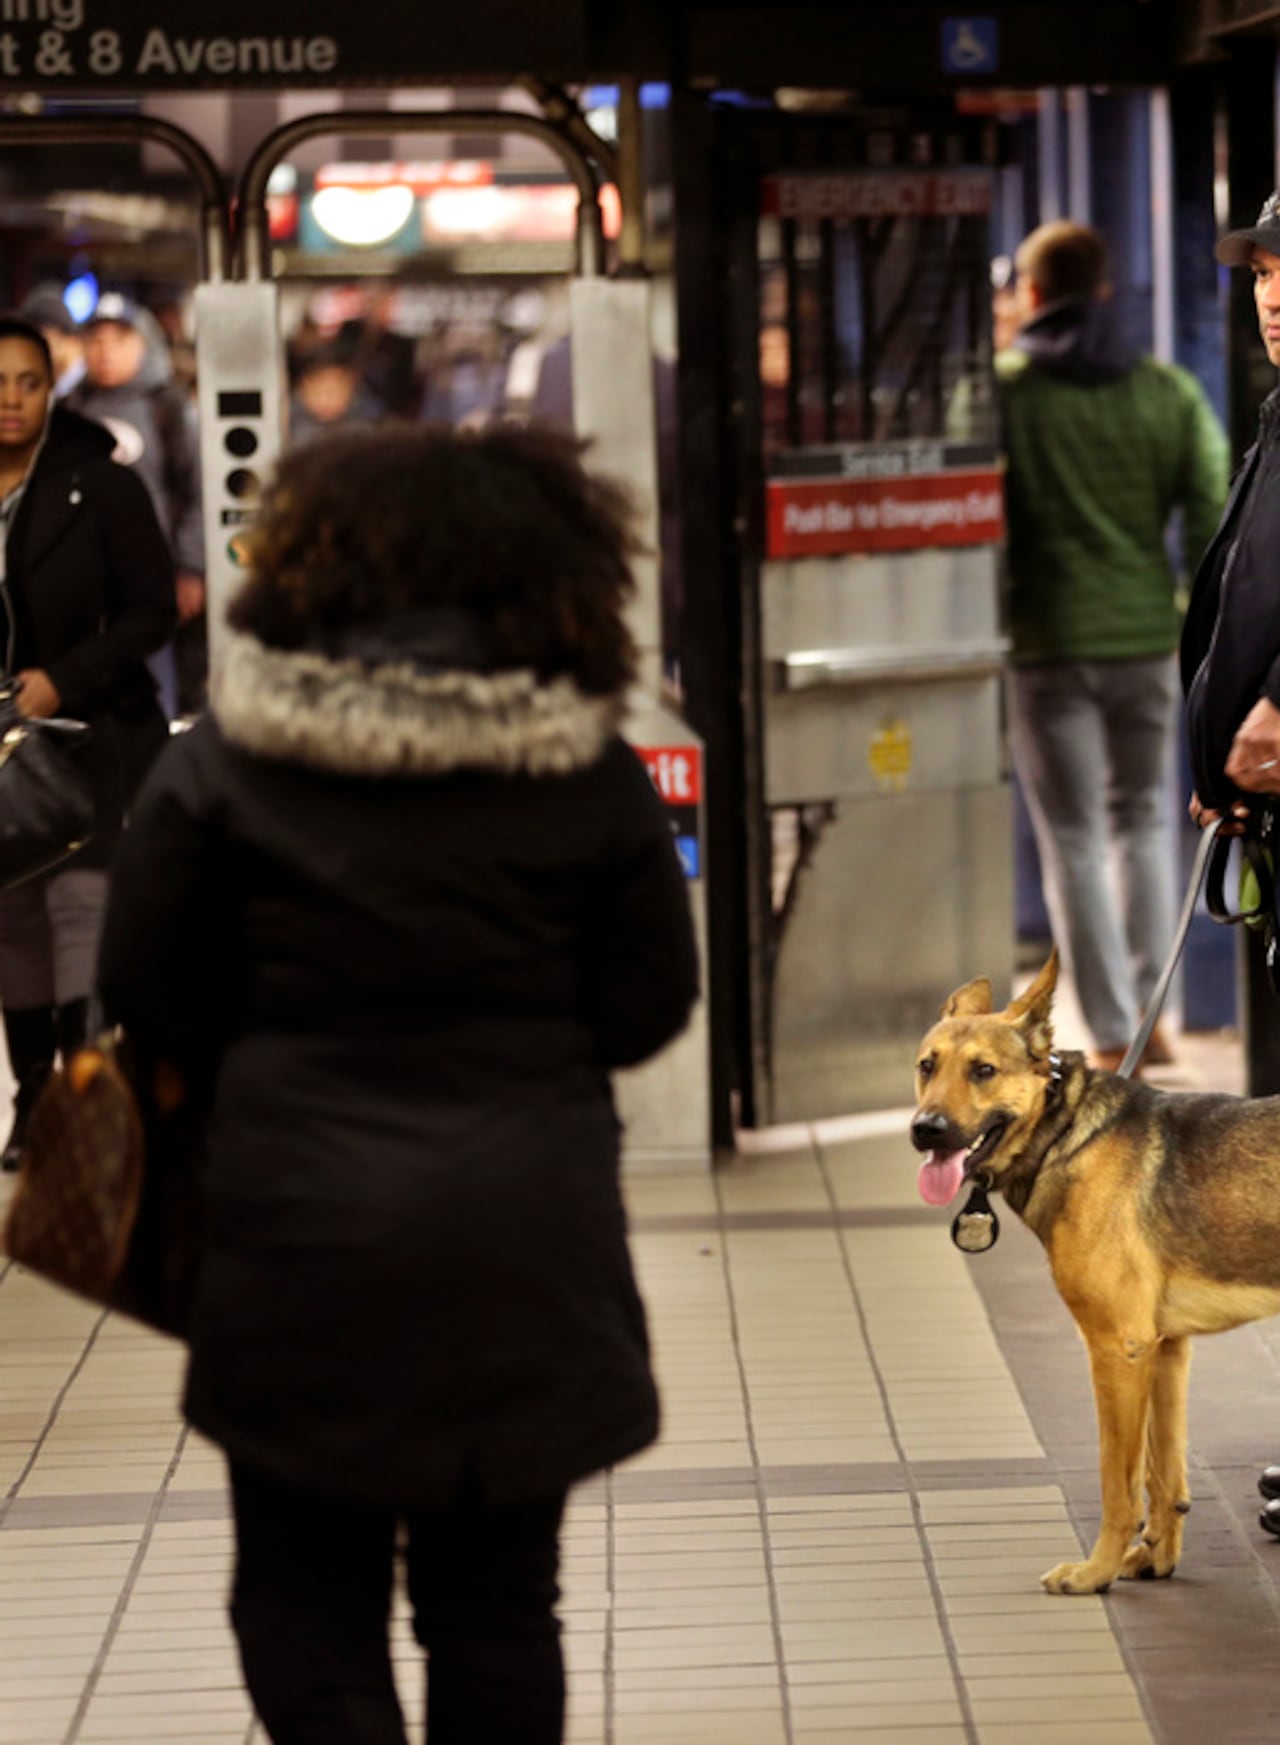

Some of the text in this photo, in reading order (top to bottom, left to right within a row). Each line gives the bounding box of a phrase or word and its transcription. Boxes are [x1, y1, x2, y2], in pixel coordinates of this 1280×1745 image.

[34, 30, 75, 76] &
[88, 30, 123, 76] 8
[136, 29, 338, 76] Avenue
